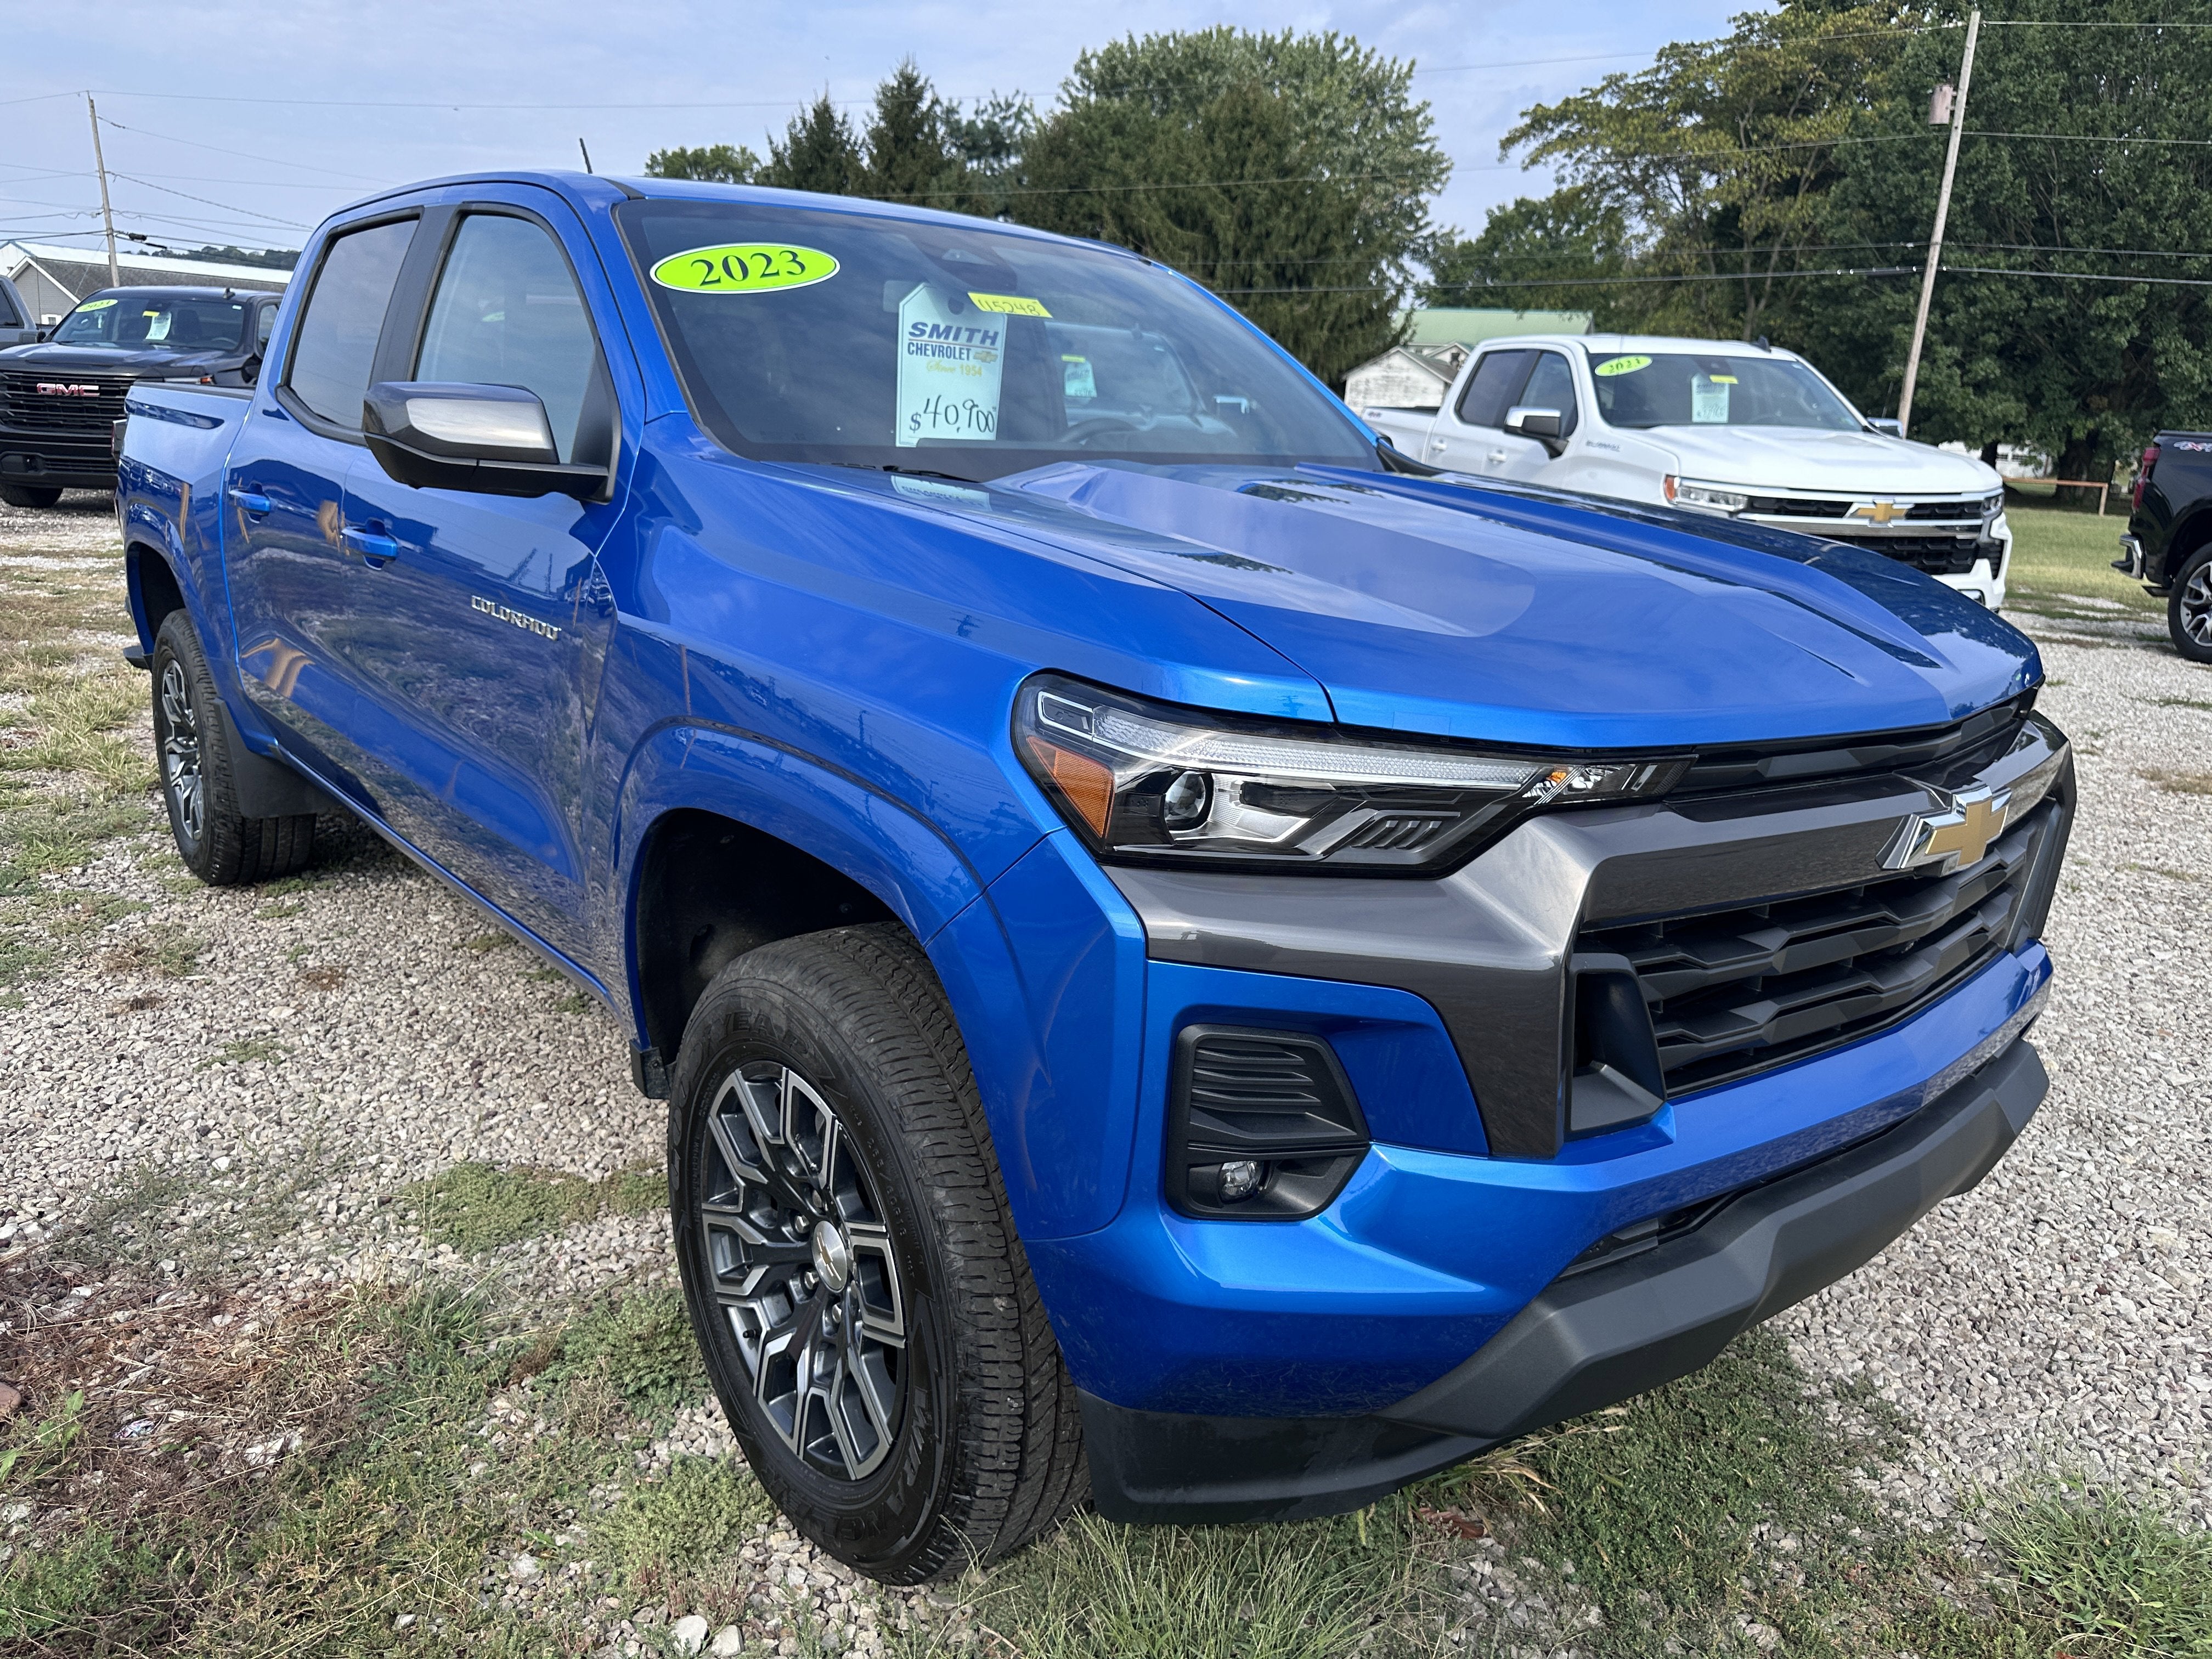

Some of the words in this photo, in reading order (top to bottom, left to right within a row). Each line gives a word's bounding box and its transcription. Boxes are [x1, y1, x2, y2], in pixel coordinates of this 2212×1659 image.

[690, 250, 806, 287] 2023
[909, 321, 1000, 346] SMITH
[907, 342, 972, 361] CHEVROLET
[960, 363, 983, 377] 1954
[37, 383, 100, 397] GMC
[471, 595, 560, 641] COLORADO
